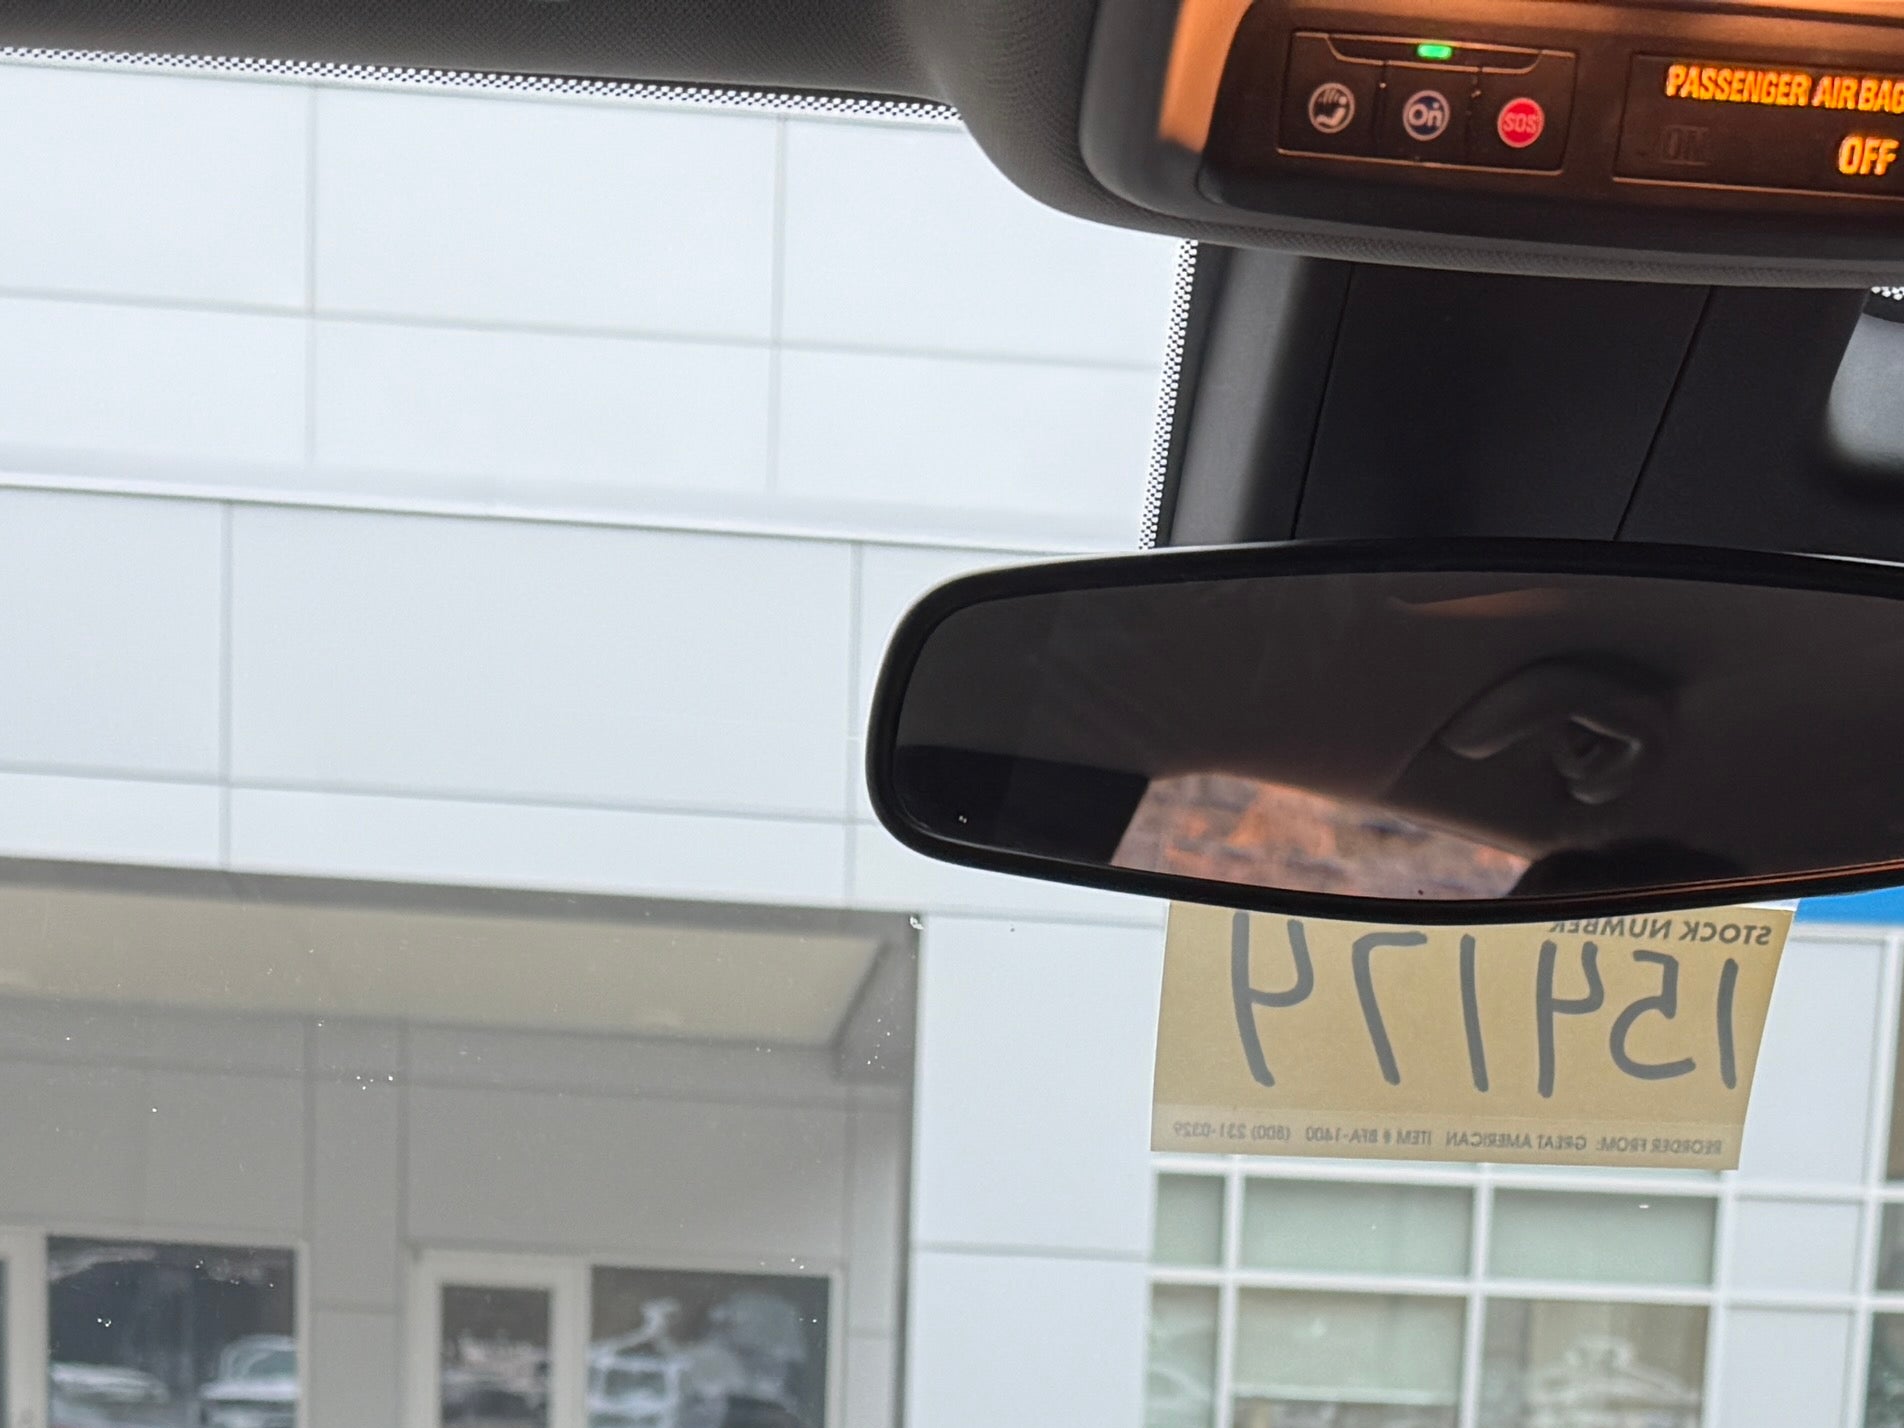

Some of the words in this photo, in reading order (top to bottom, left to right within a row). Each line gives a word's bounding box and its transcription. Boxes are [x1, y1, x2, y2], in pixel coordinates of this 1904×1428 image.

[1666, 64, 1812, 107] PASSENGER
[1501, 112, 1539, 134] SOS
[1838, 136, 1900, 175] OFF
